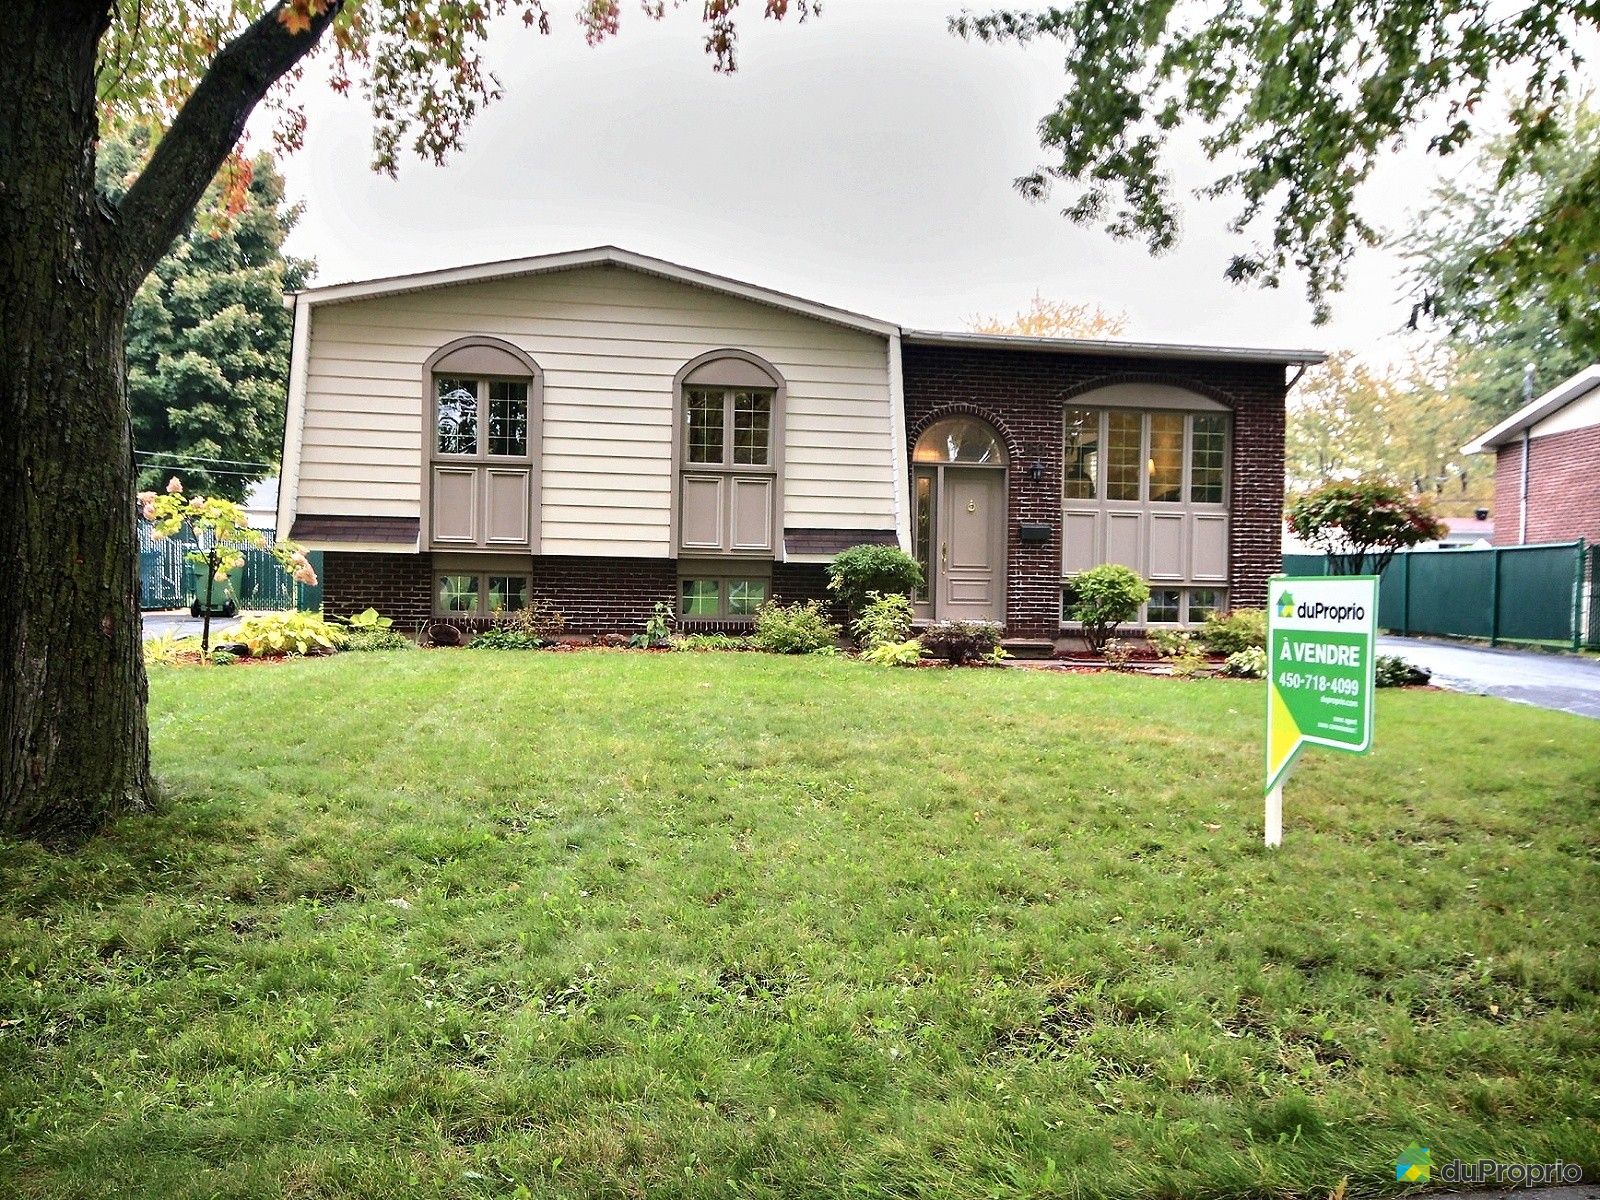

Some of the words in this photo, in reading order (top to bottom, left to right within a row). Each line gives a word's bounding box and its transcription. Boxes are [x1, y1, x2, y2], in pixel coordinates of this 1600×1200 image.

[1297, 602, 1365, 623] duProprio
[1280, 637, 1292, 661] À
[1293, 642, 1360, 667] VENDRE
[1279, 672, 1359, 696] 450-718-4099
